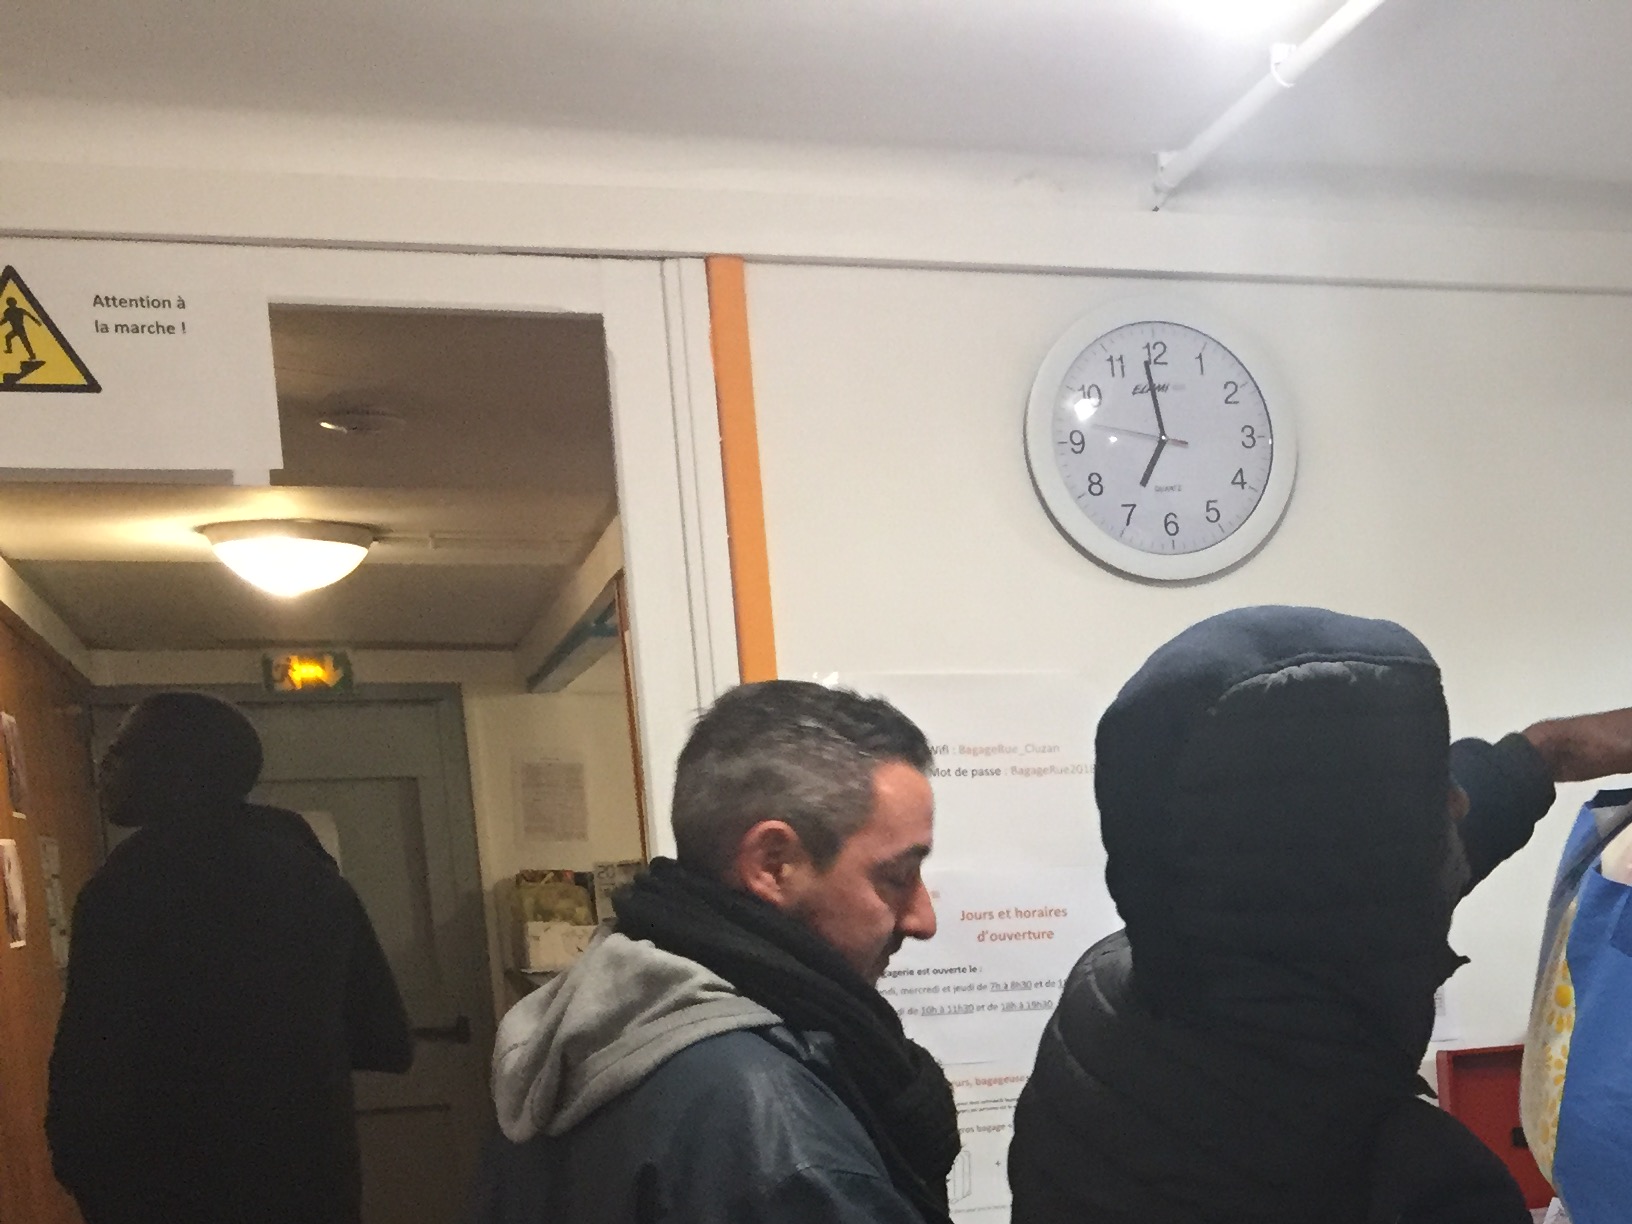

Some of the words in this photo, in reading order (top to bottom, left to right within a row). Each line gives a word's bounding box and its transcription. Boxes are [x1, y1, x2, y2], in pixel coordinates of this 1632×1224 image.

[93, 294, 172, 309] Attention
[177, 295, 186, 309] à
[94, 319, 109, 333] la
[115, 321, 176, 334] marche
[181, 321, 186, 334] !
[1142, 341, 1168, 365] 12
[1195, 352, 1204, 375] 1
[1107, 355, 1125, 378] 11
[1077, 384, 1102, 407] 10
[1223, 381, 1239, 404] 2
[1069, 430, 1085, 454] 9
[1241, 425, 1256, 448] 3
[1088, 473, 1103, 496] 8
[1231, 468, 1247, 490] 4
[1121, 504, 1137, 526] 7
[1205, 500, 1221, 522] 5
[1164, 513, 1179, 536] 6
[955, 767, 968, 776] de
[971, 768, 1001, 778] passe
[960, 910, 994, 921] Jours
[998, 909, 1011, 919] et
[1015, 906, 1068, 919] horaires
[977, 930, 1054, 942] d'ouverture
[917, 967, 930, 976] est
[933, 965, 967, 975] ouverte
[969, 965, 978, 973] le
[901, 984, 940, 995] mercredi
[942, 984, 951, 992] et
[953, 983, 974, 994] jeudi
[977, 982, 987, 991] de
[1034, 980, 1043, 988] et
[1045, 979, 1056, 988] de
[987, 1003, 998, 1011] de
